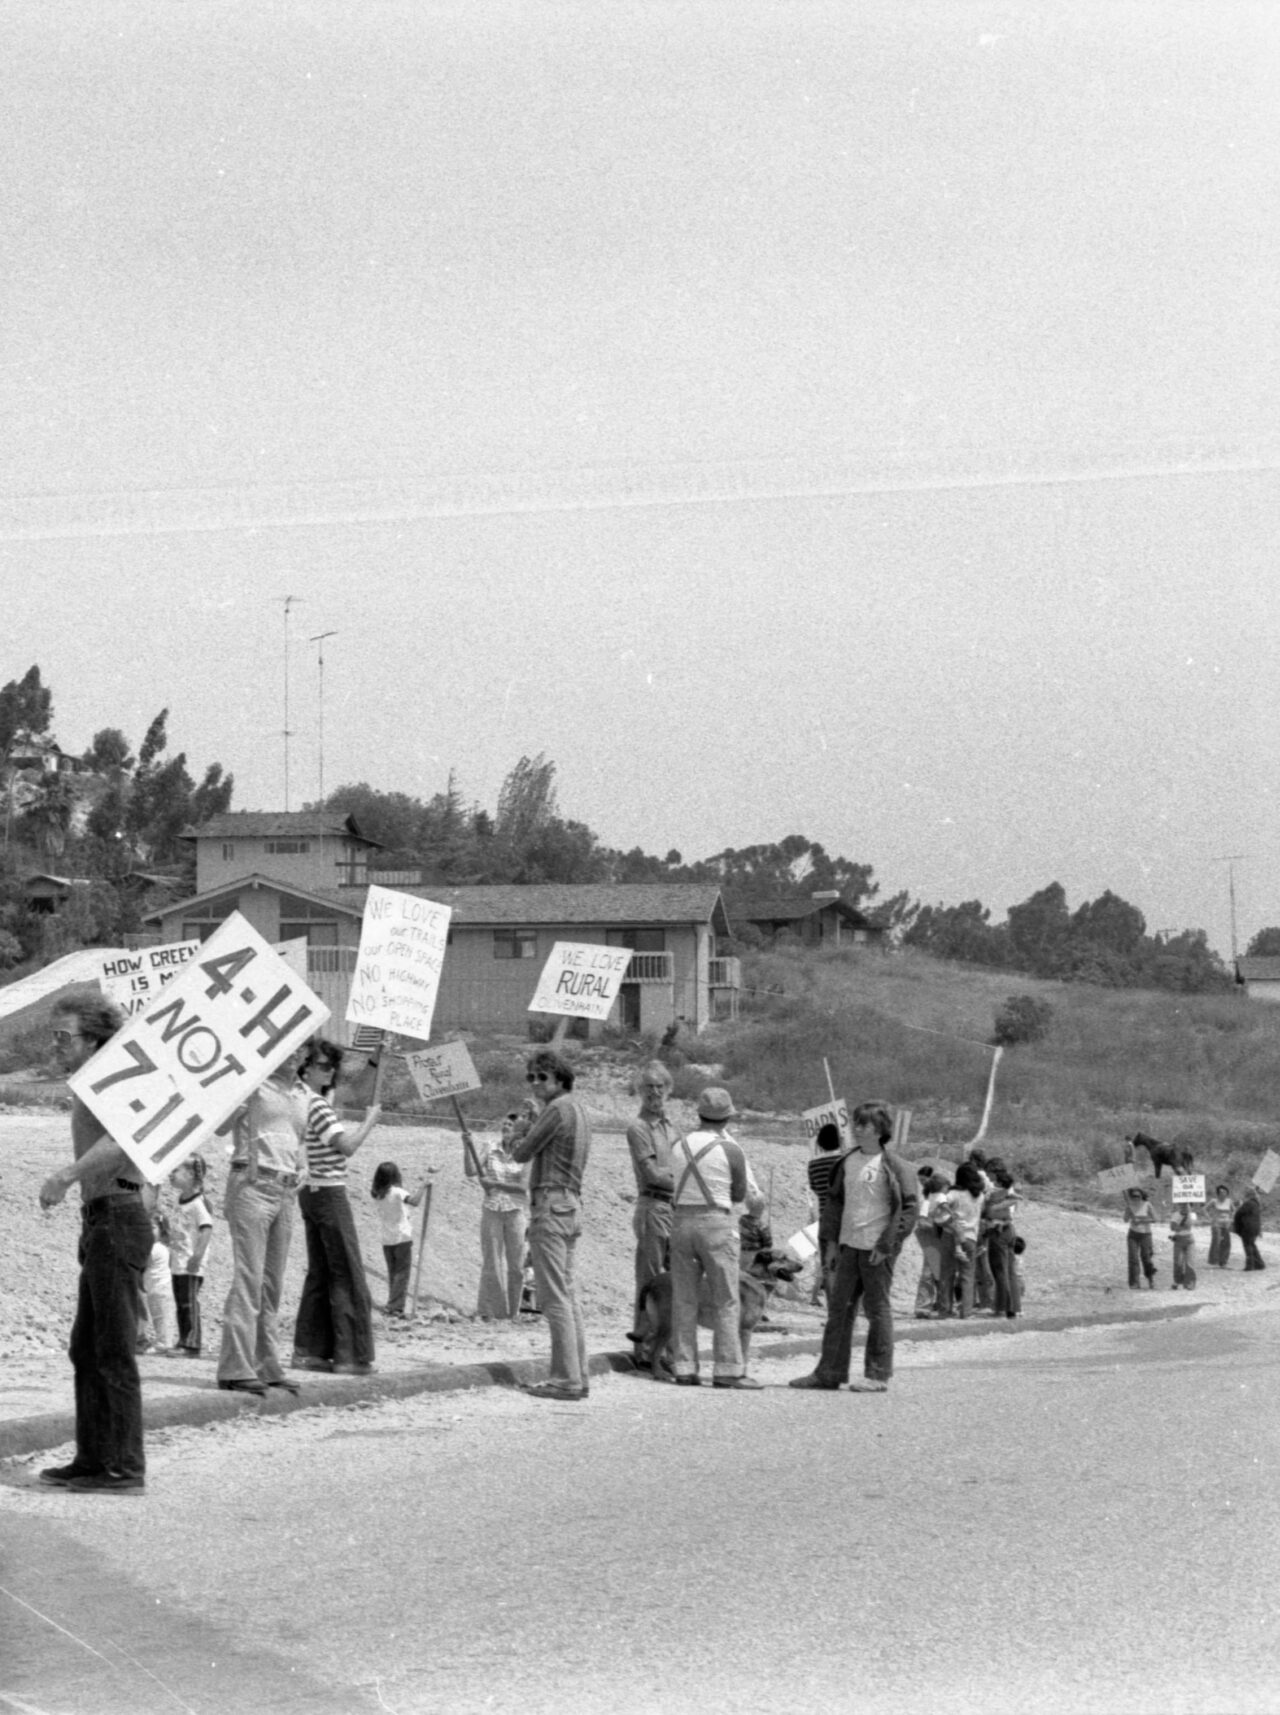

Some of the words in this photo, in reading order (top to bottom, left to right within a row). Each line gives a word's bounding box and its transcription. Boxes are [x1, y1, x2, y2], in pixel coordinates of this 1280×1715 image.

[368, 897, 393, 920] WE
[402, 899, 442, 929] LOVE
[386, 941, 413, 960] OPEN
[410, 926, 446, 952] TRAILS
[103, 956, 142, 976] HOW
[560, 950, 585, 967] WE
[590, 953, 625, 971] LOVE
[130, 976, 150, 992] IS
[159, 970, 178, 986] M
[360, 963, 382, 986] NO
[388, 969, 431, 993] HIGHWAY
[555, 969, 611, 999] RURAL
[199, 946, 313, 1058] 4-H
[352, 993, 376, 1017] NO
[390, 1010, 425, 1032] PLACE
[145, 998, 247, 1089] NOT
[89, 1040, 204, 1164] 7-11
[1178, 1175, 1197, 1184] SAVE
